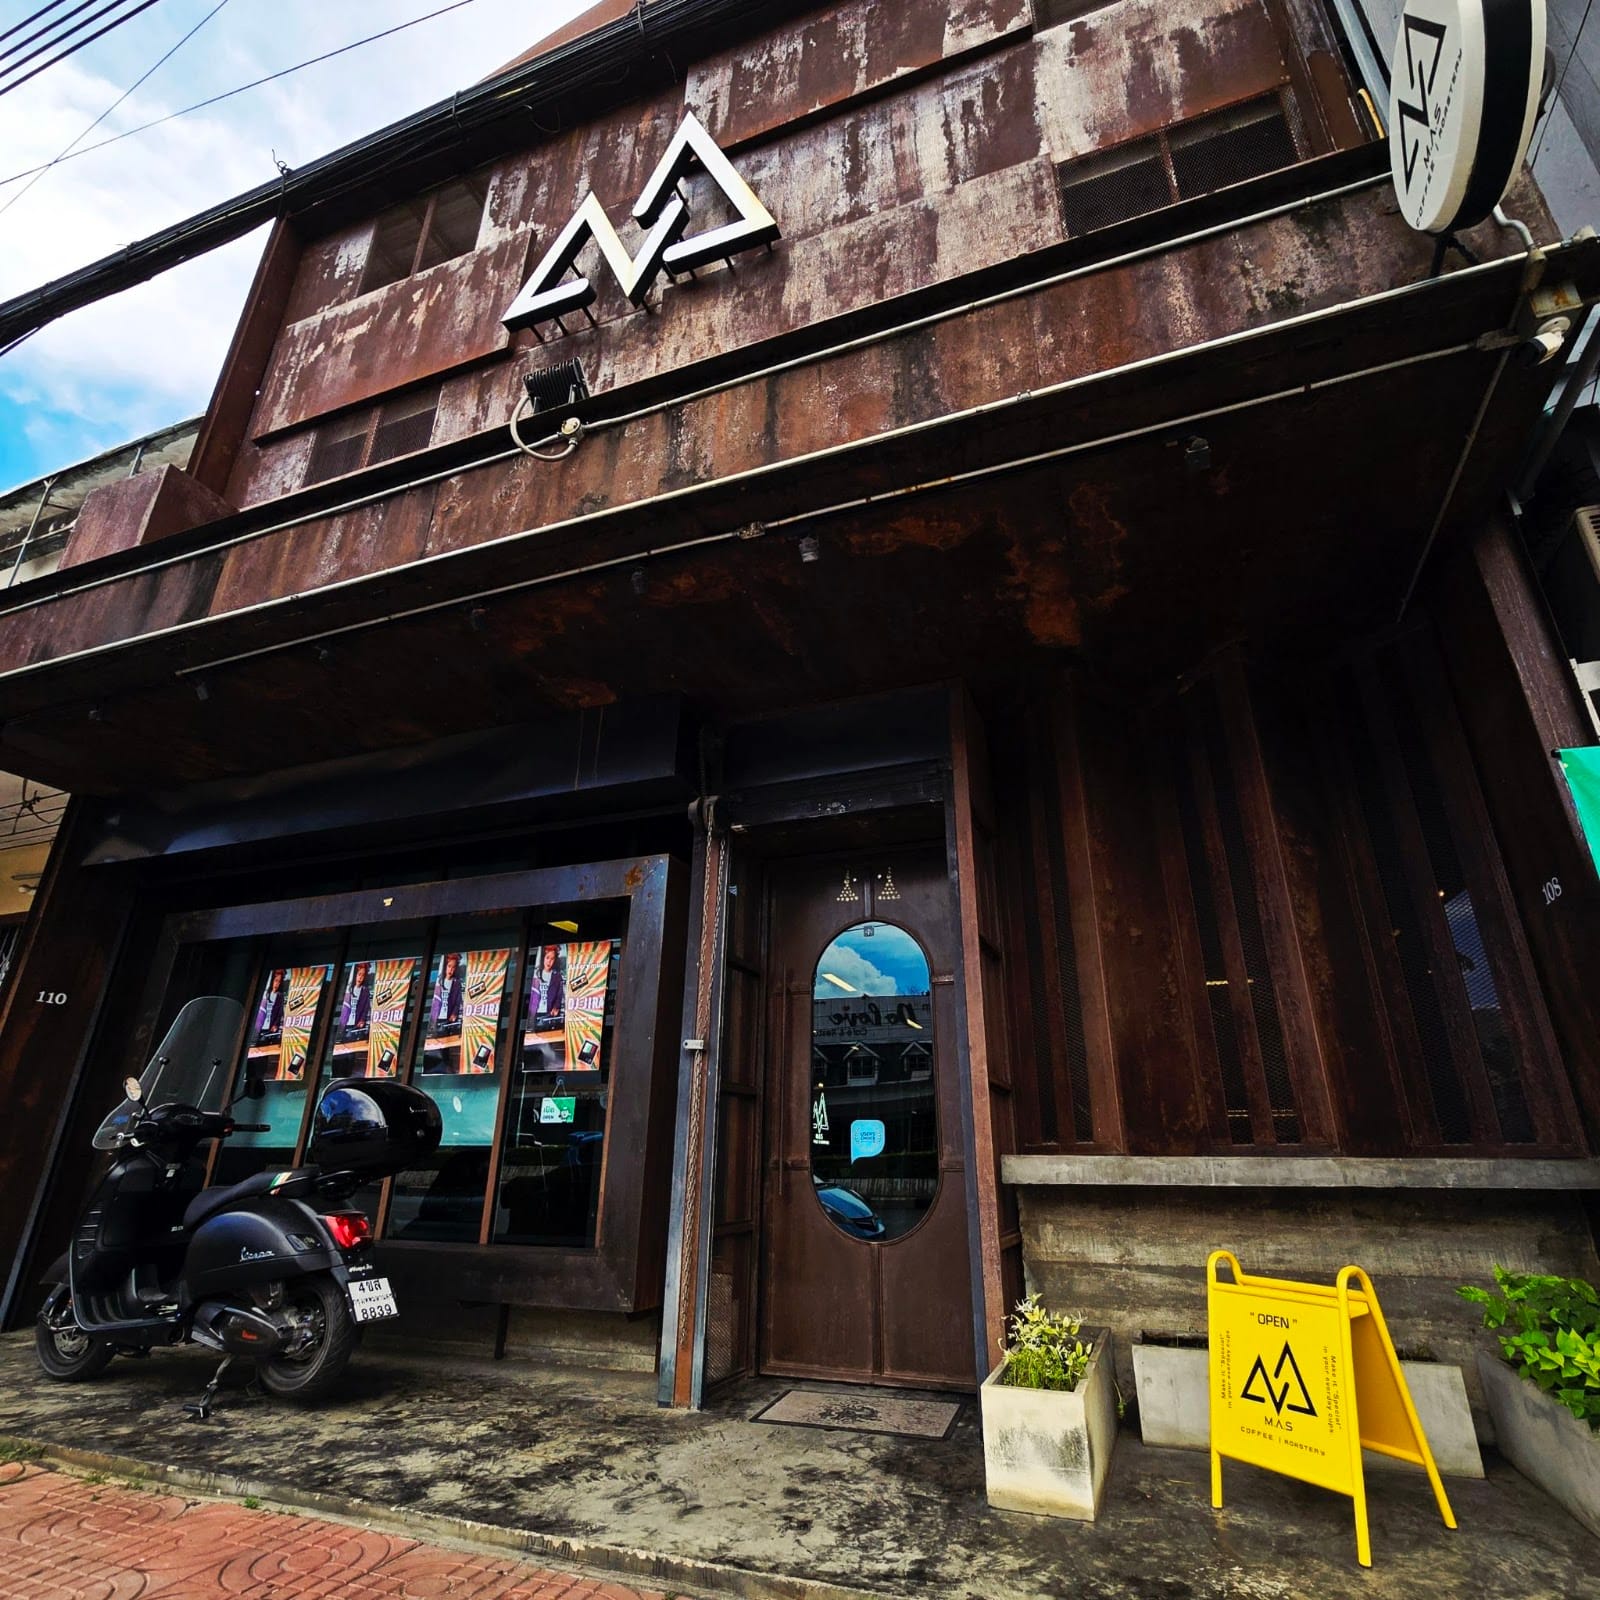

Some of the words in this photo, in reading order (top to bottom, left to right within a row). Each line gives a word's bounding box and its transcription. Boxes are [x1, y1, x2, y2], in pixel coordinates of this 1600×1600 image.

[1542, 877, 1562, 904] 108
[36, 990, 68, 1005] 110
[361, 1303, 392, 1320] 8839
[1240, 1426, 1273, 1441] COFFEE
